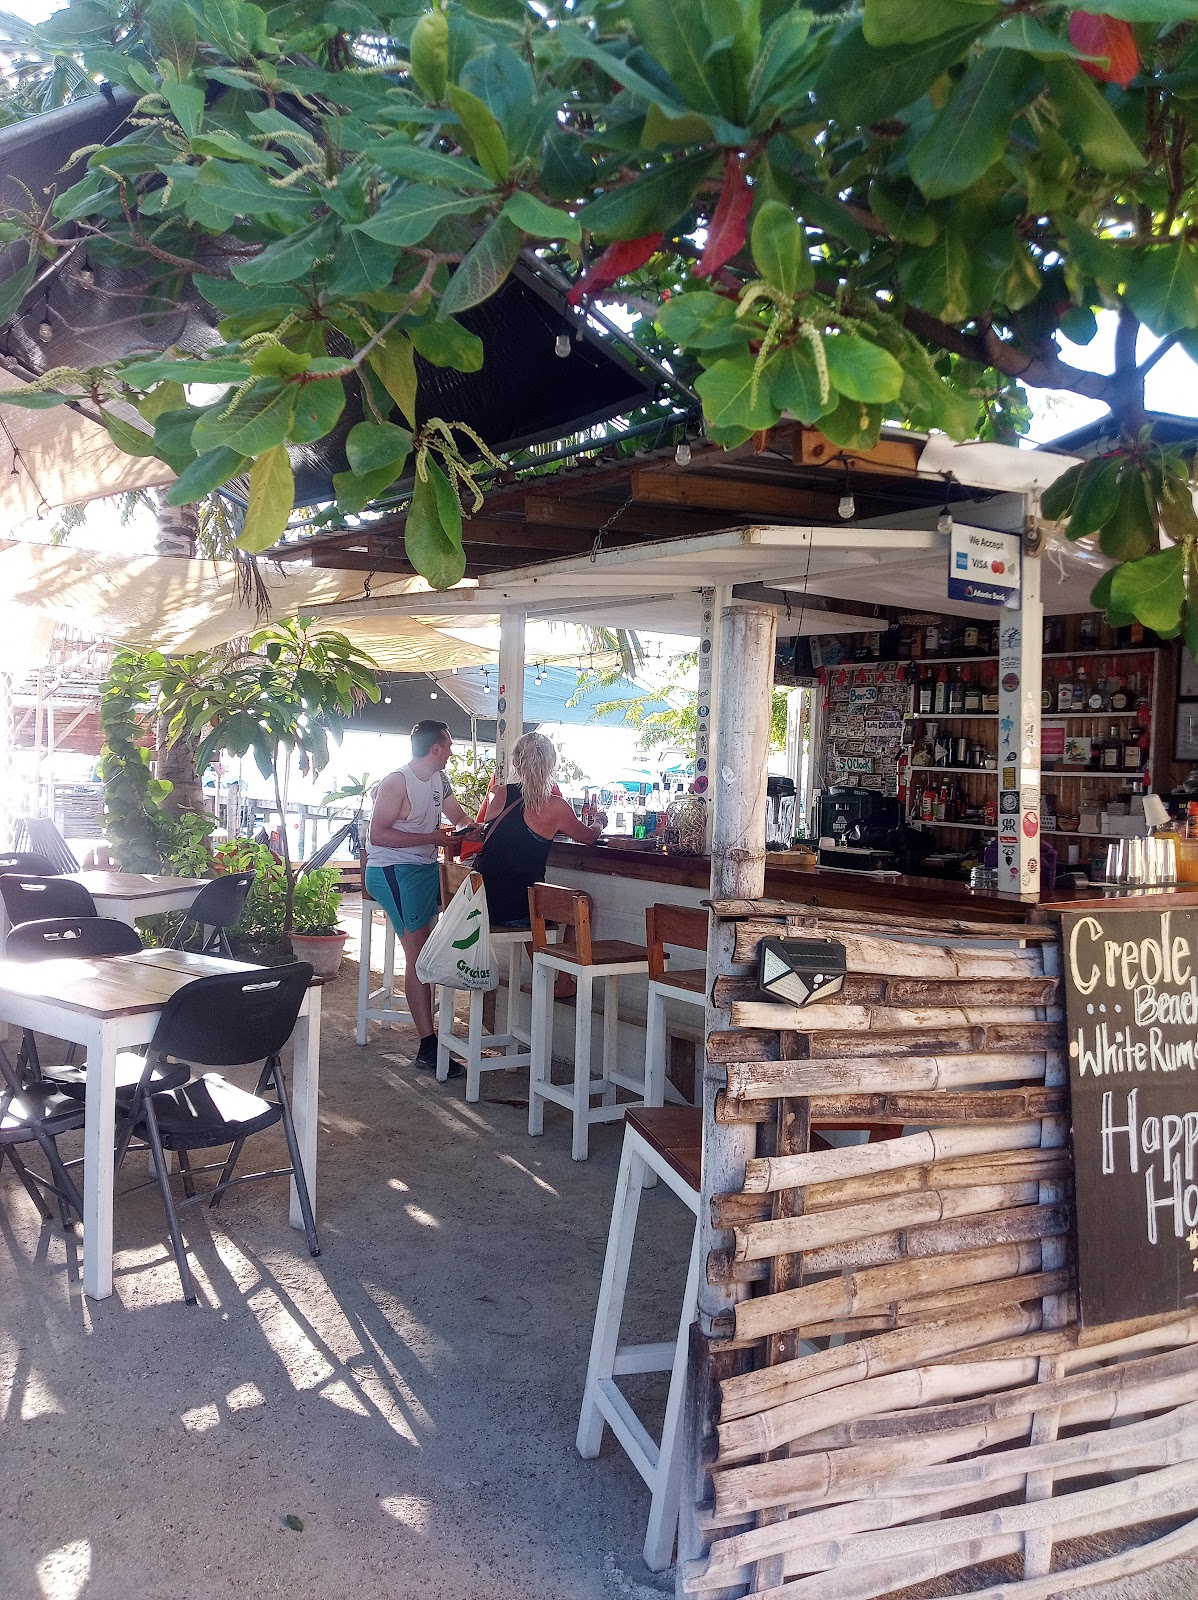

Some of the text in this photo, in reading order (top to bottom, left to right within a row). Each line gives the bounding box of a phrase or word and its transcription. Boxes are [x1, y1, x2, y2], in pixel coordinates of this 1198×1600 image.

[969, 535, 1004, 550] We Accept
[971, 558, 988, 569] VISA
[839, 757, 847, 769] 5
[1069, 911, 1191, 995] Creole
[456, 959, 490, 978] Gracias
[1078, 1022, 1148, 1077] White
